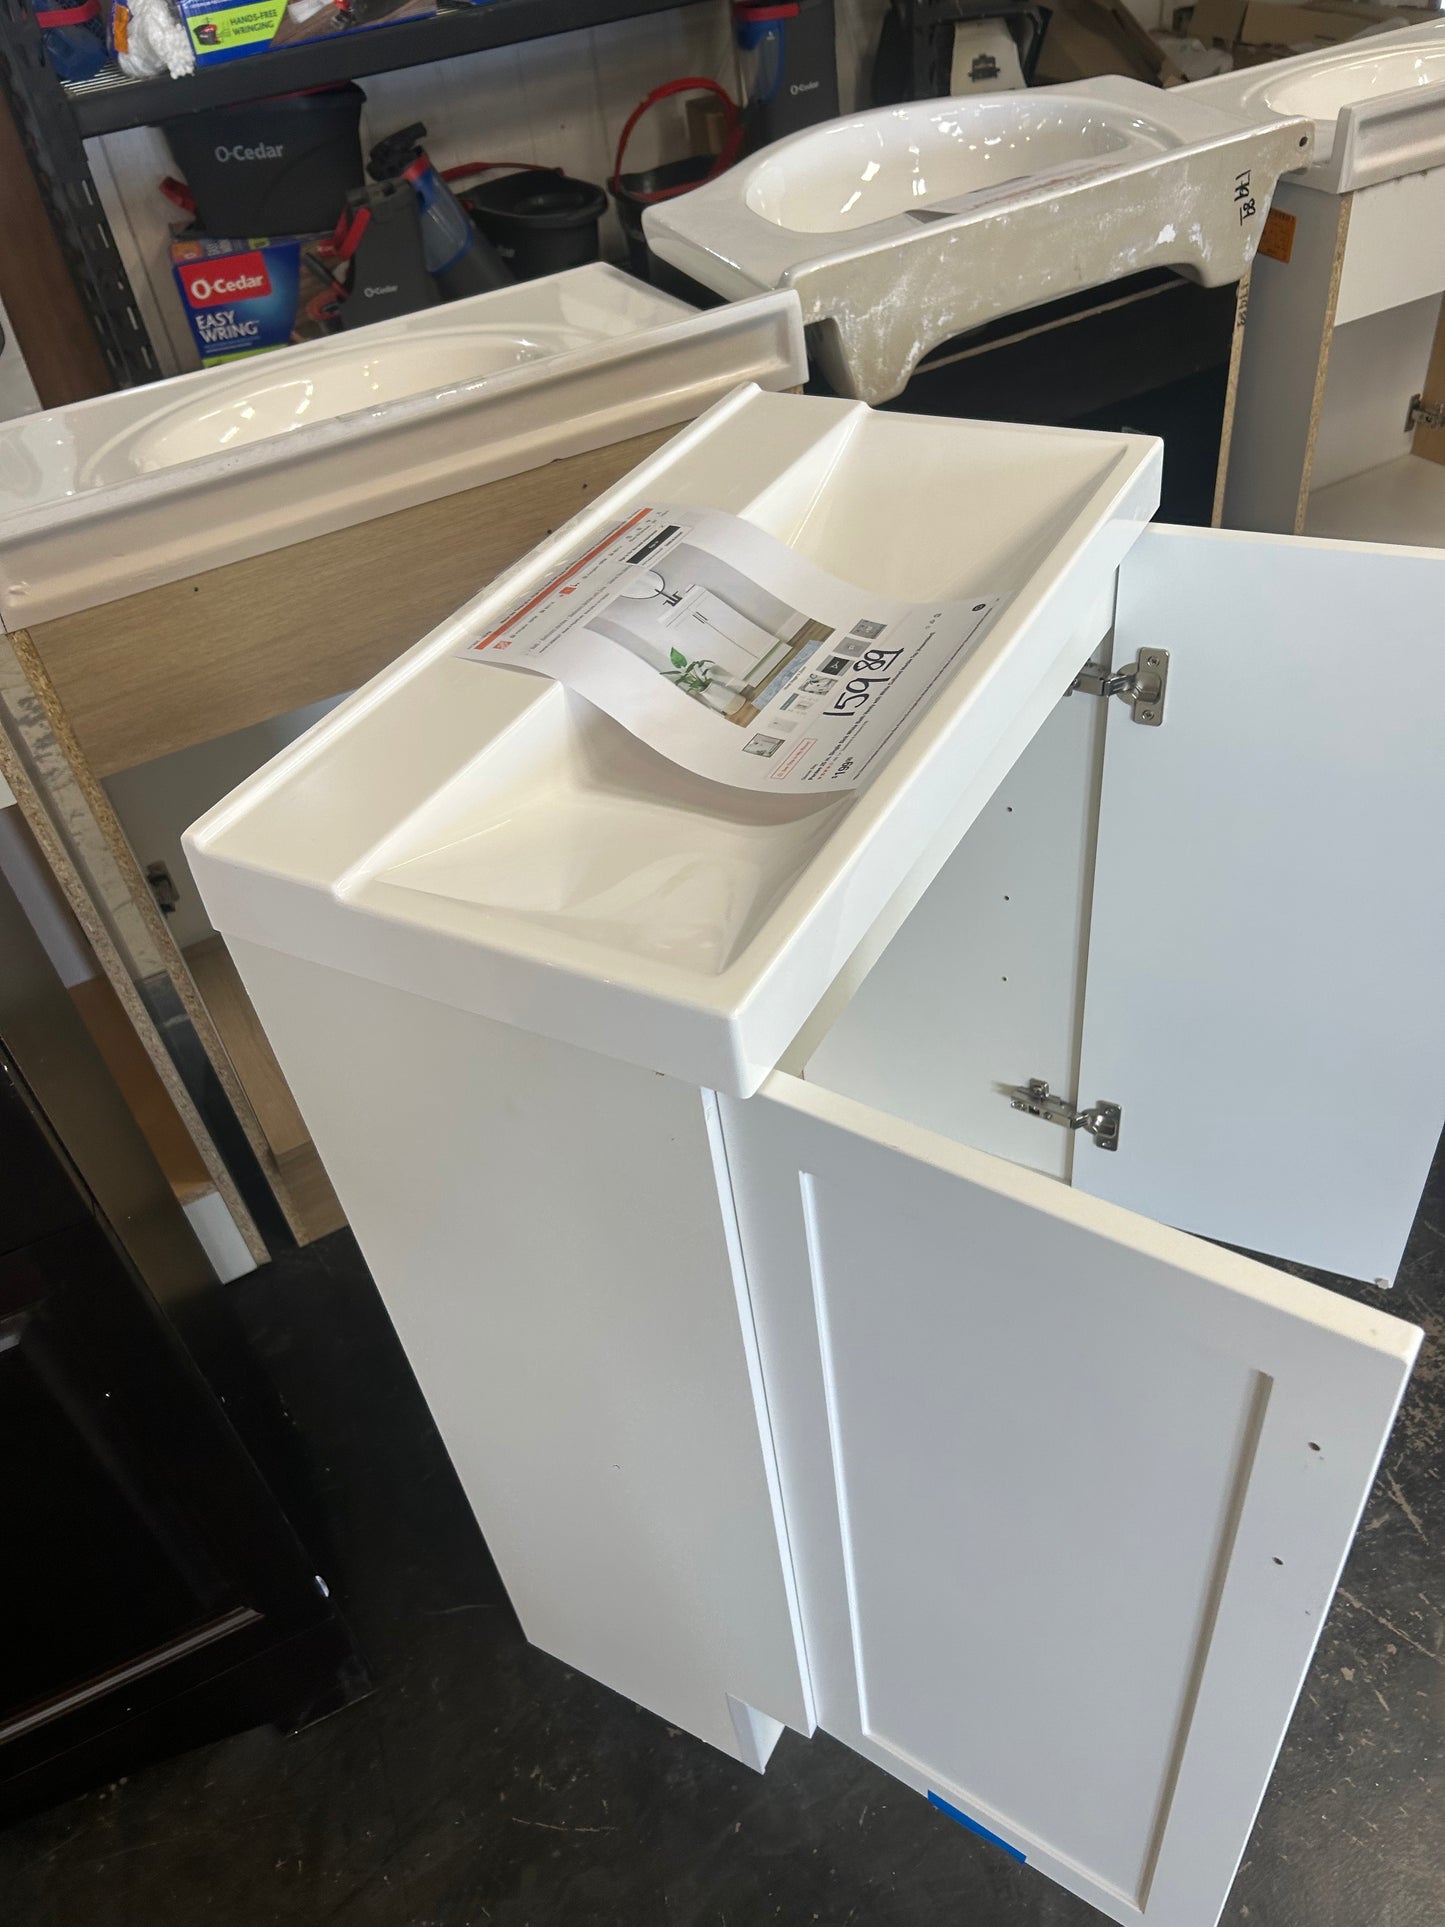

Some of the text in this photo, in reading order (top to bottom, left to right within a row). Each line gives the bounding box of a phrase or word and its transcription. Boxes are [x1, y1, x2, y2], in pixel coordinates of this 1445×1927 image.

[229, 9, 278, 25] HANDS-FREE
[231, 20, 274, 35] WRINGING
[214, 142, 284, 163] O-Cedar
[190, 274, 265, 300] O-Cedar
[195, 310, 234, 330] EASY
[199, 320, 259, 343] WRING
[853, 647, 904, 672] 89
[823, 677, 891, 717] 159
